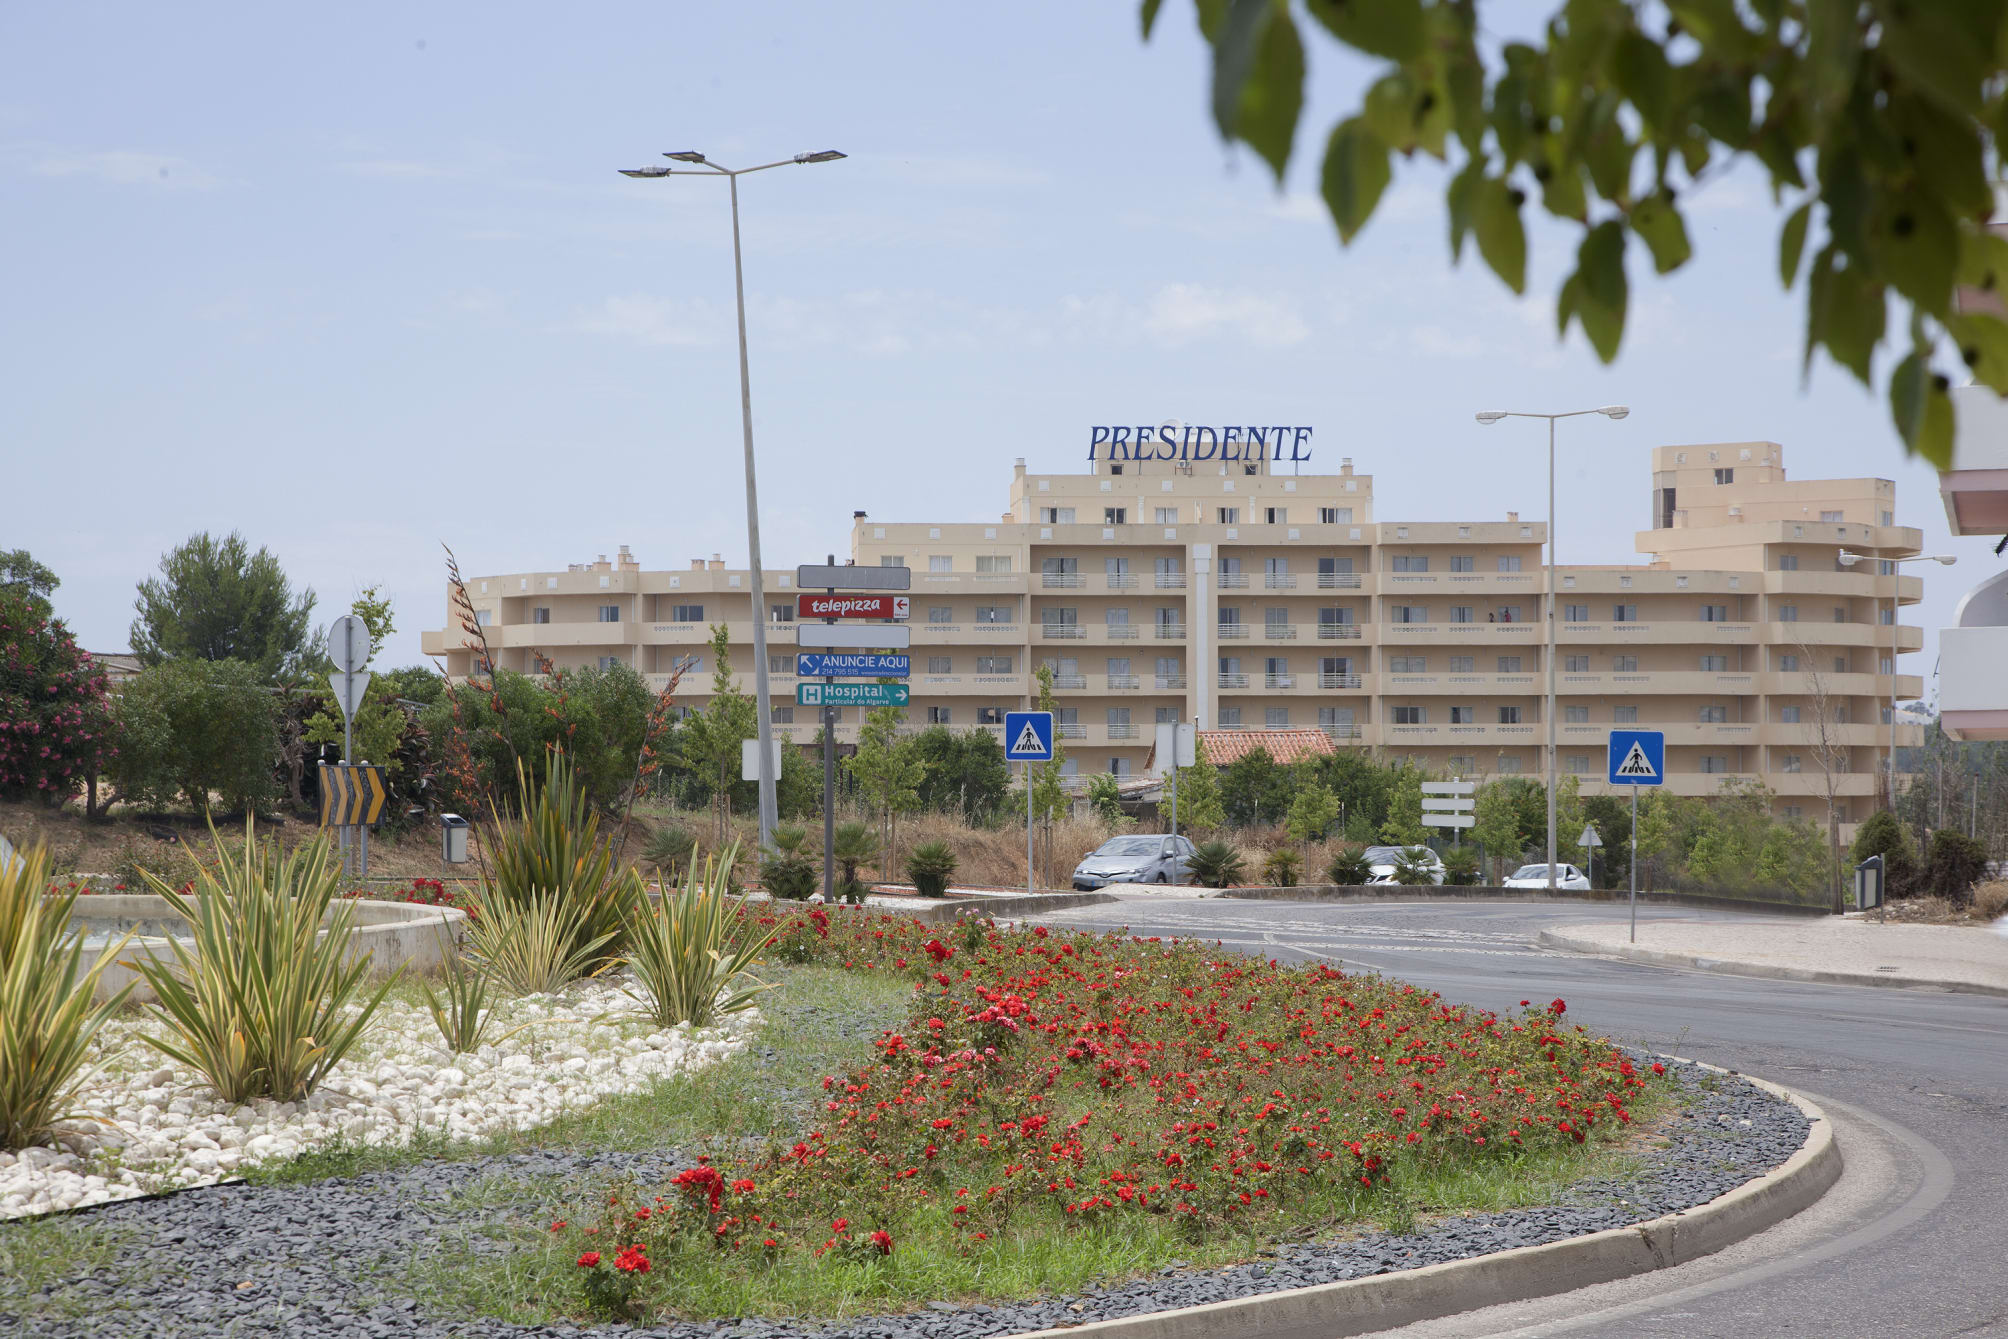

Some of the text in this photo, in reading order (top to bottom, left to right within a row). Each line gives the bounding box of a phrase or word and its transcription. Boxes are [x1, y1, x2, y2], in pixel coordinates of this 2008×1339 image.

[1087, 425, 1313, 461] PRESIDENTE
[811, 598, 881, 616] telepizza
[822, 655, 908, 668] ANUNCIE AQUI
[825, 685, 883, 699] Hospital
[866, 698, 889, 706] Algarve
